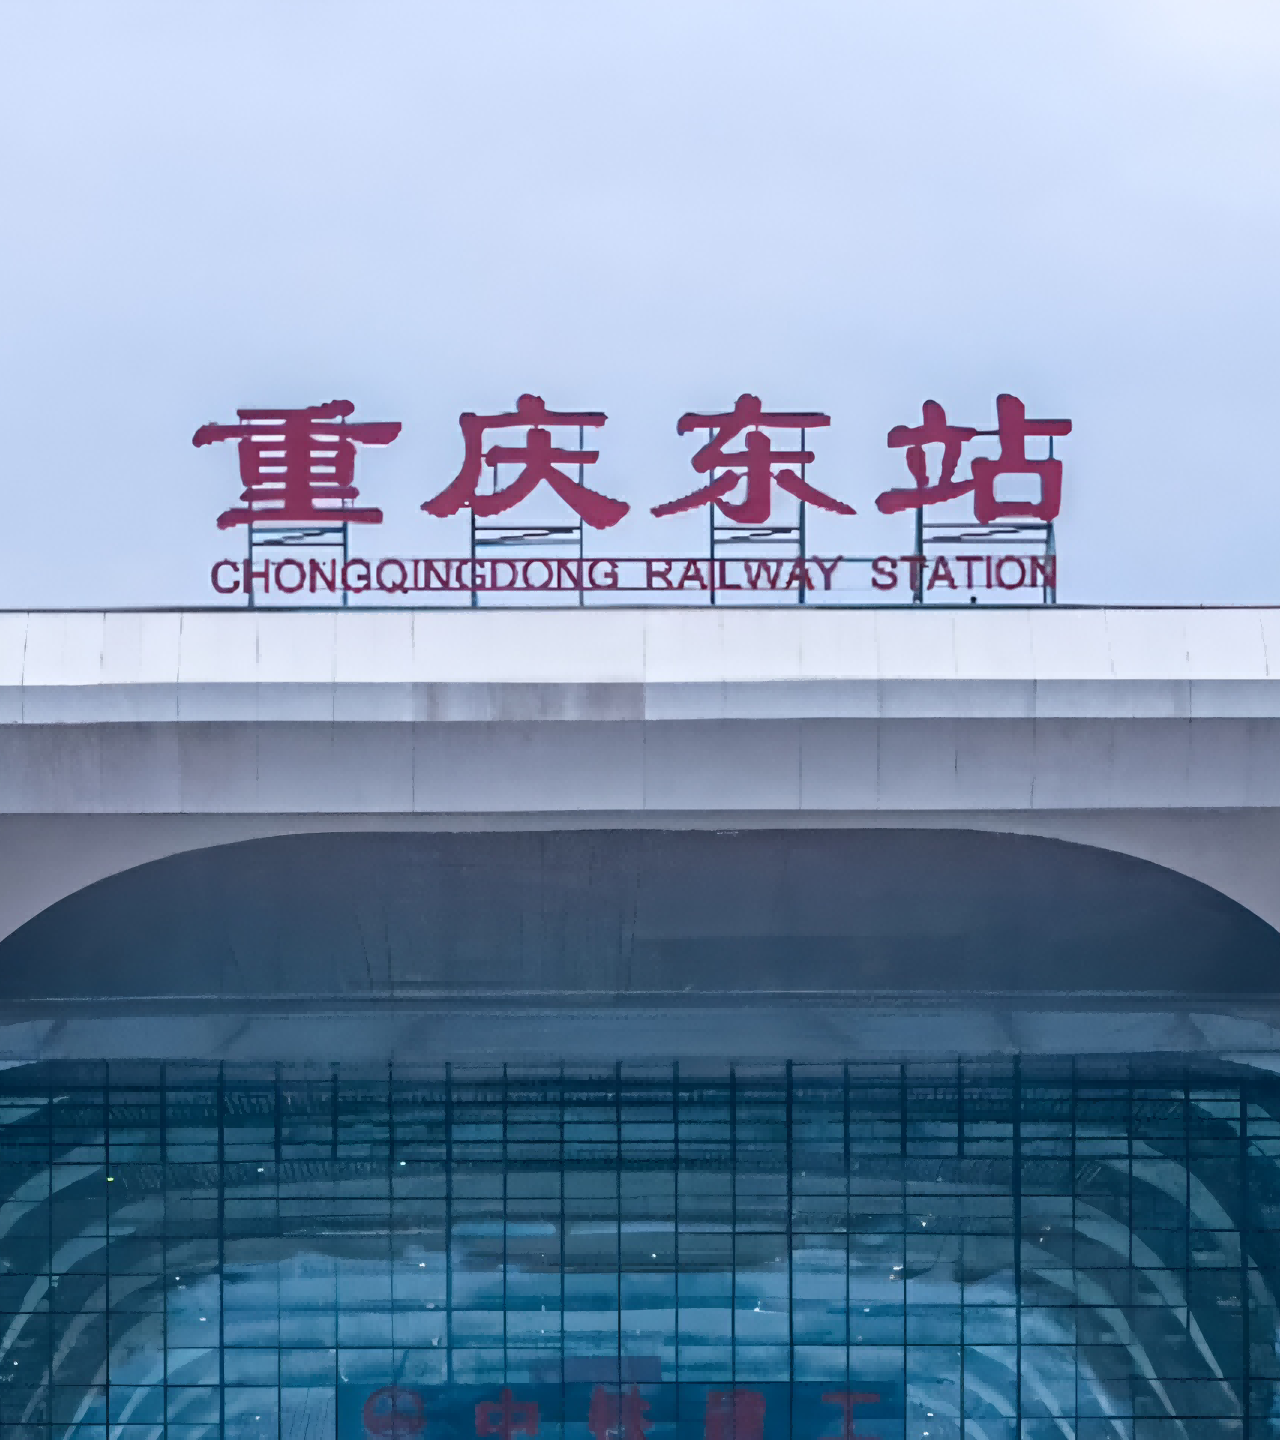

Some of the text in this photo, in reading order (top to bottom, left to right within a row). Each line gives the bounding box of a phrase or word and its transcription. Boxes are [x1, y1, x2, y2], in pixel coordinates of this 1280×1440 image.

[193, 393, 1073, 530] 重庆东站
[211, 553, 1058, 595] CHONGQINGDONG RAILWAY STATION
